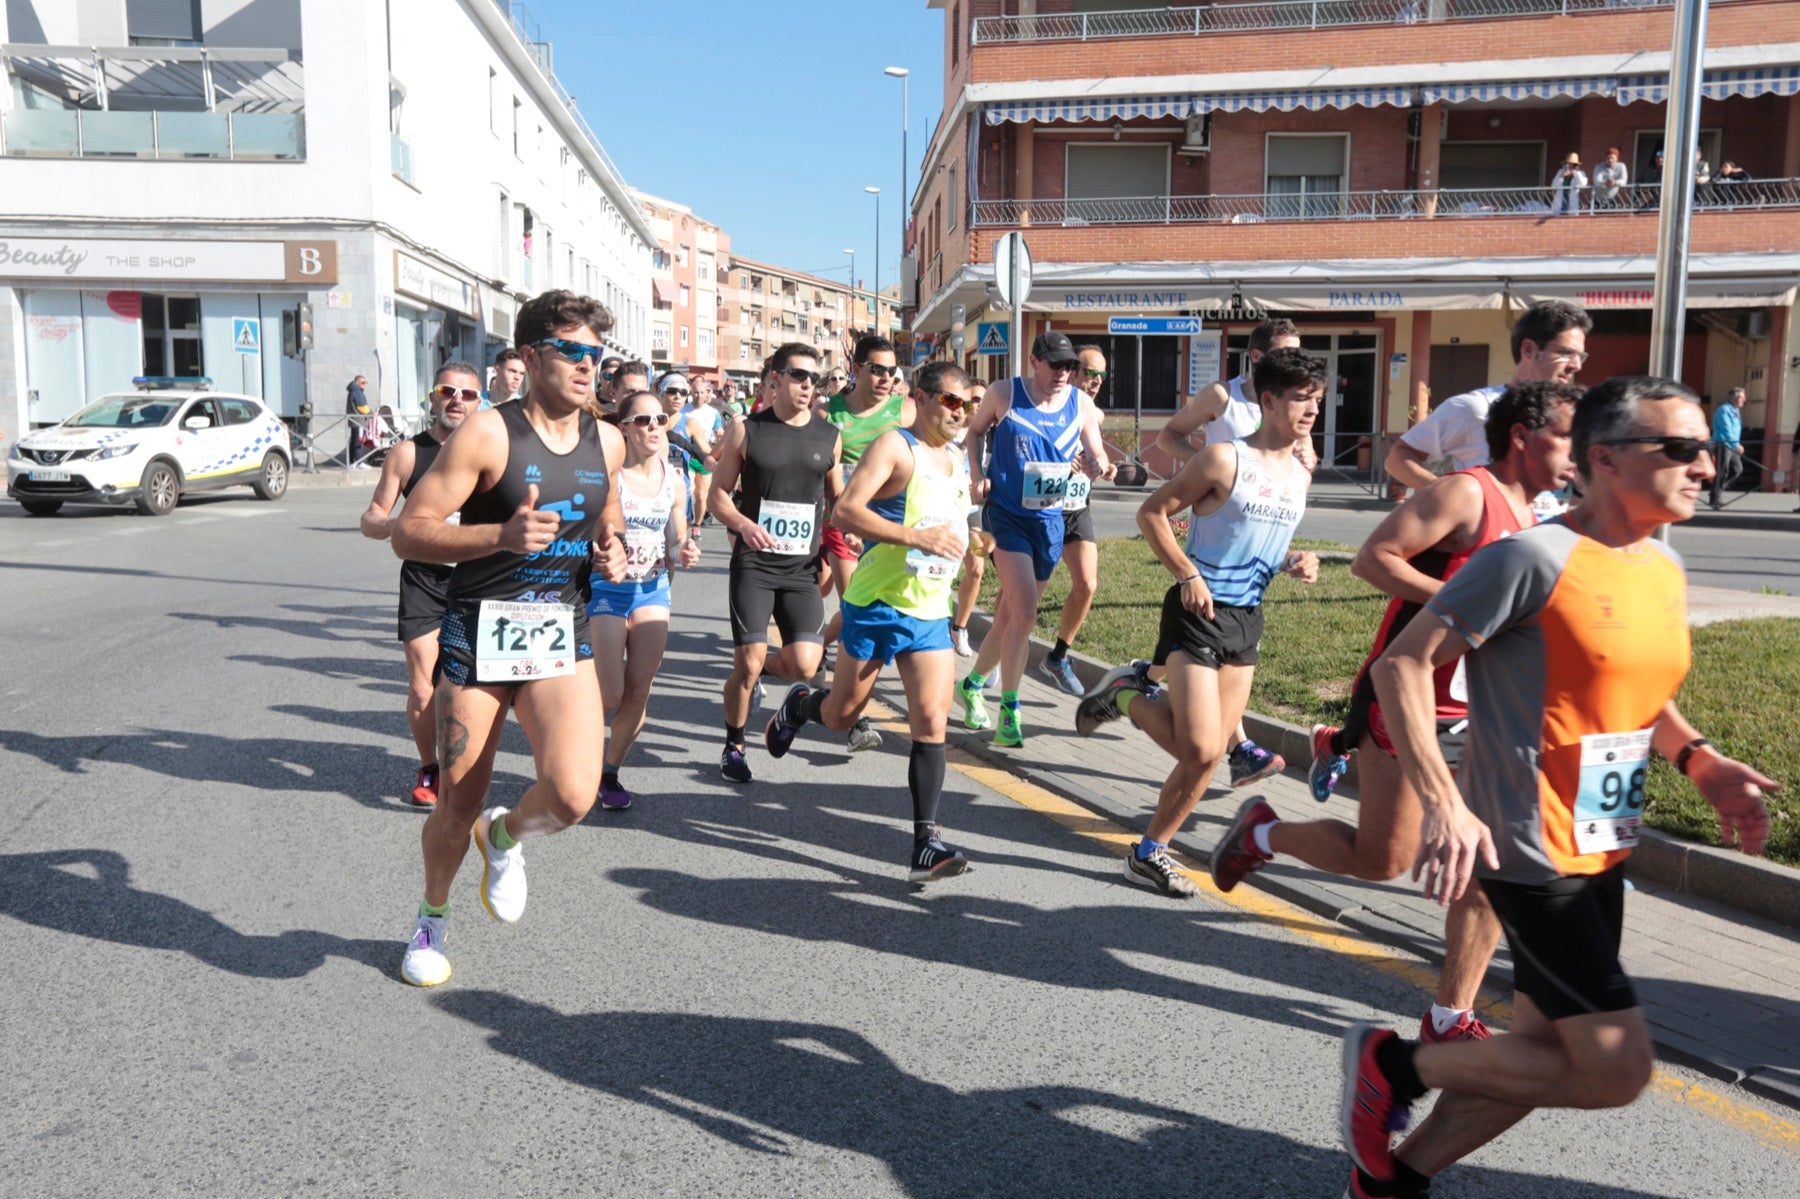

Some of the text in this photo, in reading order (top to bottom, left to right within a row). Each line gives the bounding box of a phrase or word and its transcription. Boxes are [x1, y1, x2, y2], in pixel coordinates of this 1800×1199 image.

[106, 255, 196, 267] THE SHOP
[1064, 292, 1188, 308] RESTAURANTE
[1328, 291, 1405, 307] PARADA
[1576, 289, 1654, 305] "BICHITO
[1188, 308, 1269, 320] BICHITOS
[1111, 321, 1148, 331] Granada
[763, 517, 811, 539] 1039
[1600, 770, 1645, 813] 98
